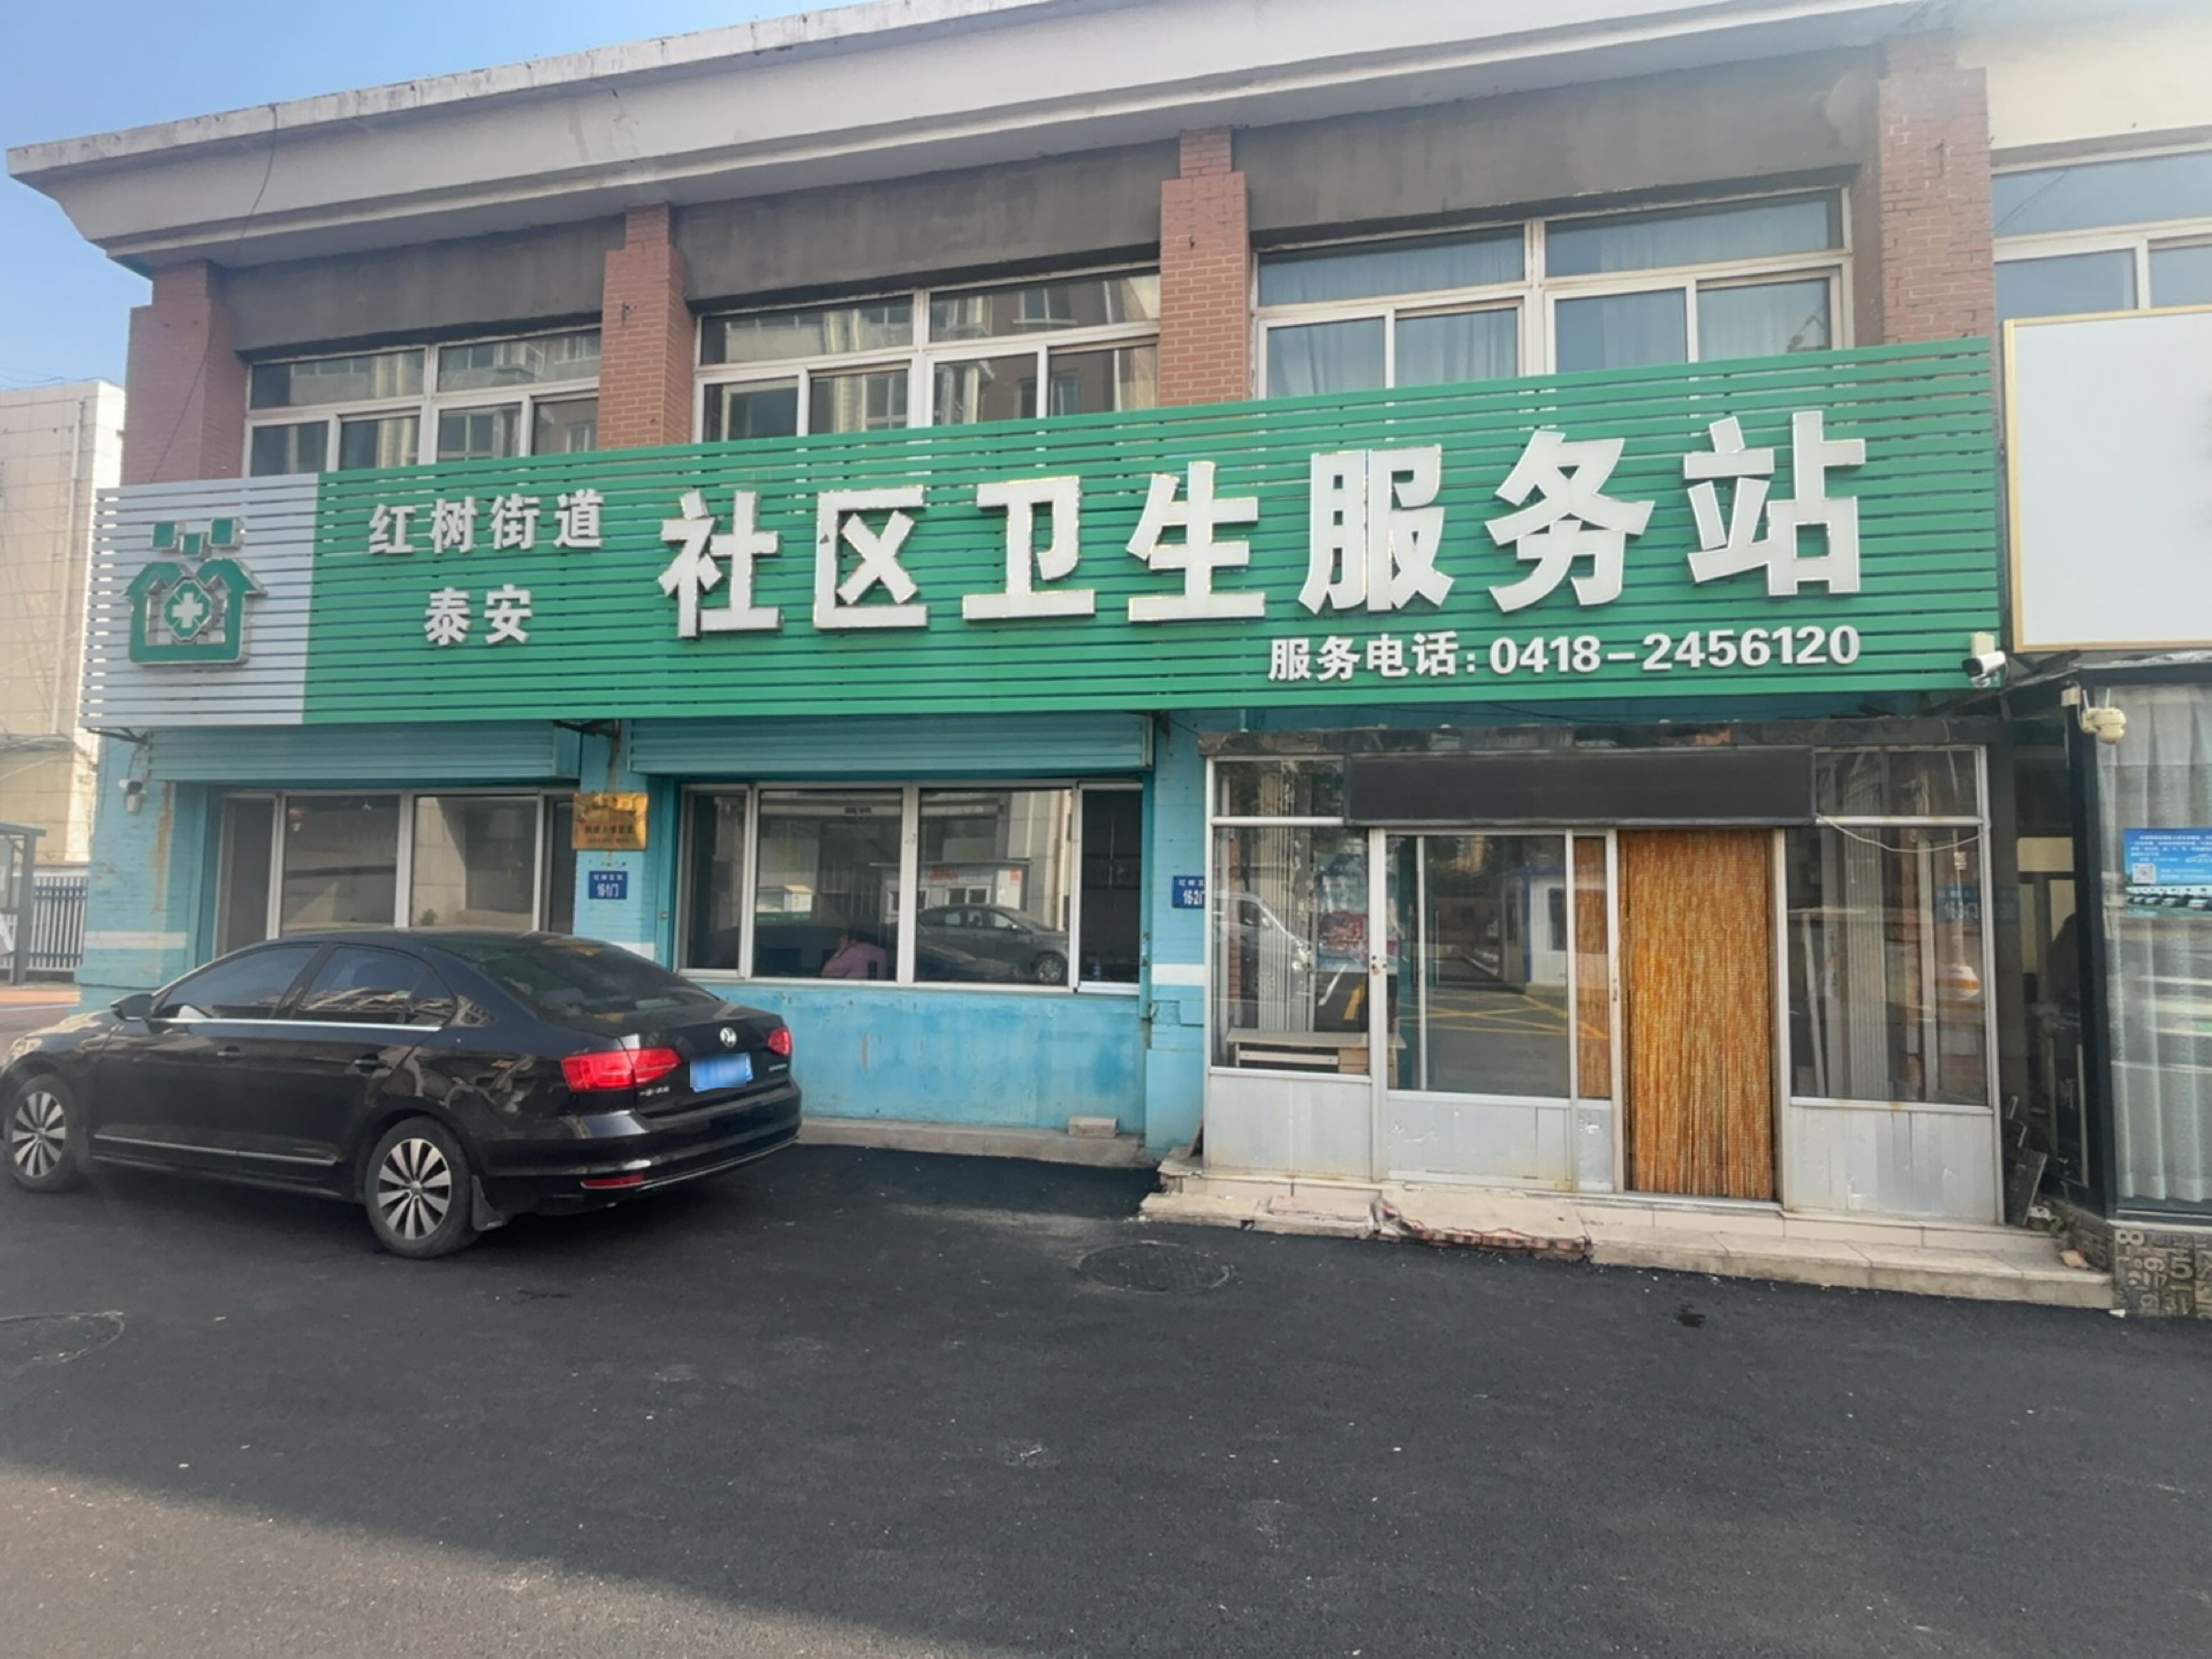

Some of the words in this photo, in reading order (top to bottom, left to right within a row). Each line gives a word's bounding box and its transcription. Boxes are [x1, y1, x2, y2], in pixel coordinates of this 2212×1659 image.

[369, 488, 604, 554] 红树街道
[658, 410, 1866, 639] 社区卫生服务站
[424, 583, 533, 646] 泰安
